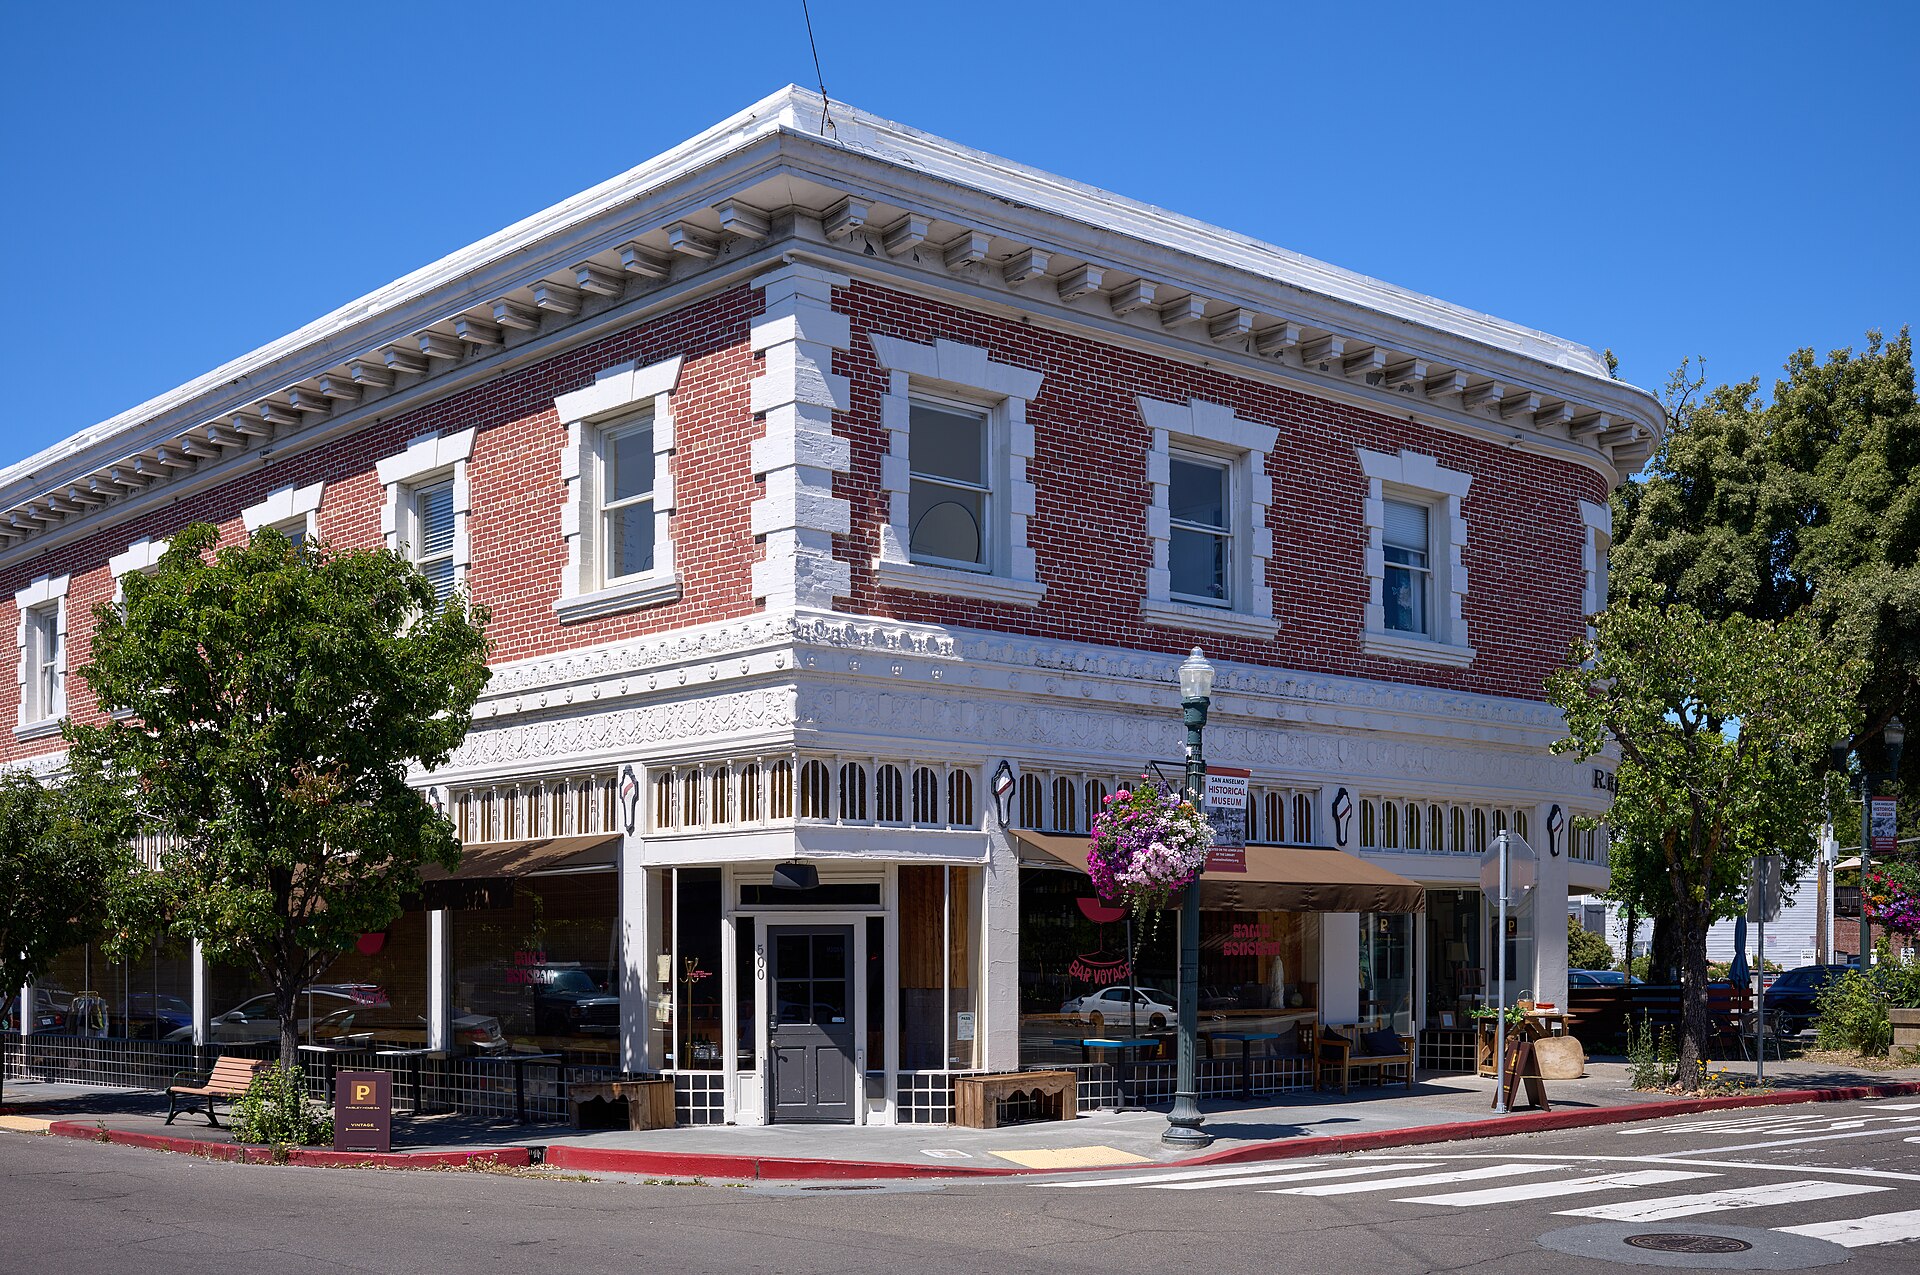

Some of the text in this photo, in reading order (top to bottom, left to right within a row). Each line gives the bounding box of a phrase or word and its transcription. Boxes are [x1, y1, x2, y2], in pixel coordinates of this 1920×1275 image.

[1222, 778, 1245, 786] ANSELMO
[1208, 785, 1246, 796] HISTORICAL
[1211, 797, 1242, 807] MUSEUM
[1508, 920, 1515, 932] P
[757, 944, 765, 980] 500
[1068, 959, 1133, 985] BAR VOYAGE
[356, 1085, 370, 1101] P
